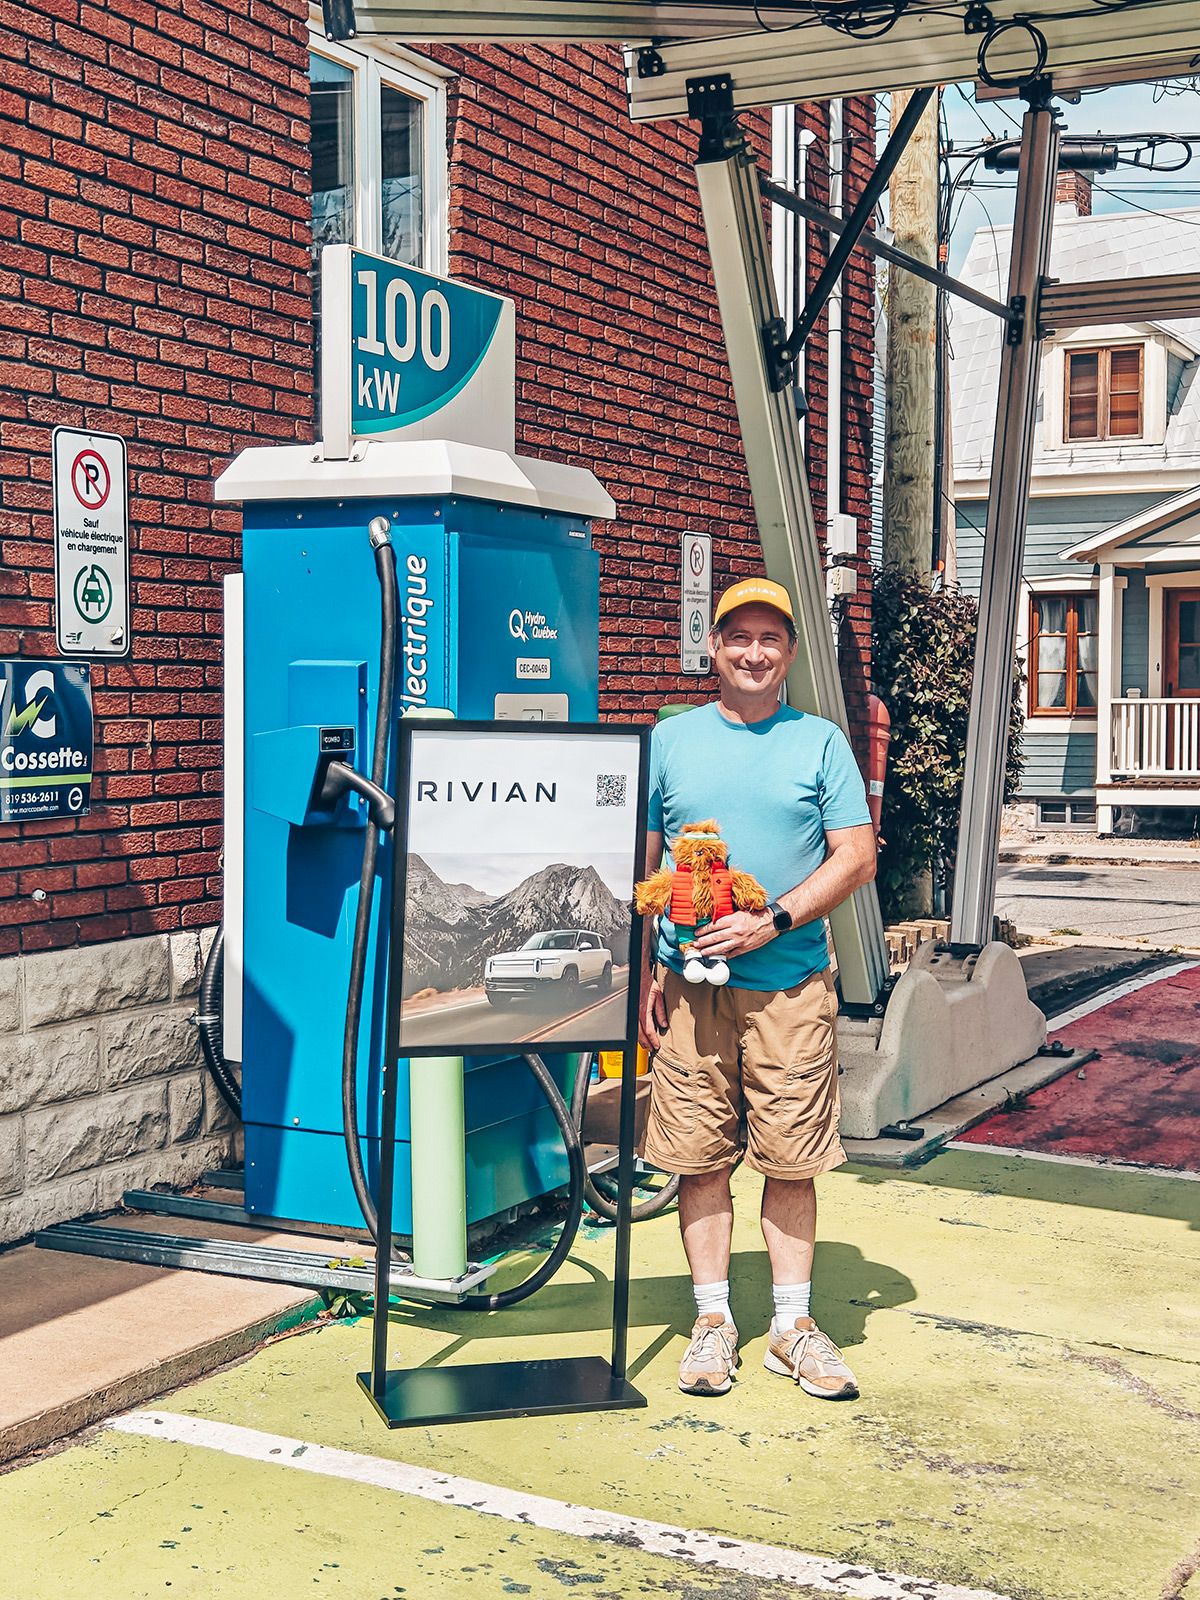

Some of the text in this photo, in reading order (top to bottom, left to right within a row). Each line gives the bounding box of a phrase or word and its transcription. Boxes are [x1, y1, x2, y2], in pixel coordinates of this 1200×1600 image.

[357, 270, 450, 371] 100
[358, 363, 401, 414] kW
[83, 517, 100, 528] Sauf
[60, 528, 124, 544] véhicule électrique
[67, 542, 118, 555] en chargement
[736, 586, 777, 598] RIVIAN
[525, 610, 546, 627] Hydro
[399, 553, 434, 714] lectrique
[532, 624, 558, 640] Québec
[1, 746, 83, 771] Cossette
[5, 791, 59, 805] 819 536-2611
[417, 780, 557, 803] RIVIAN
